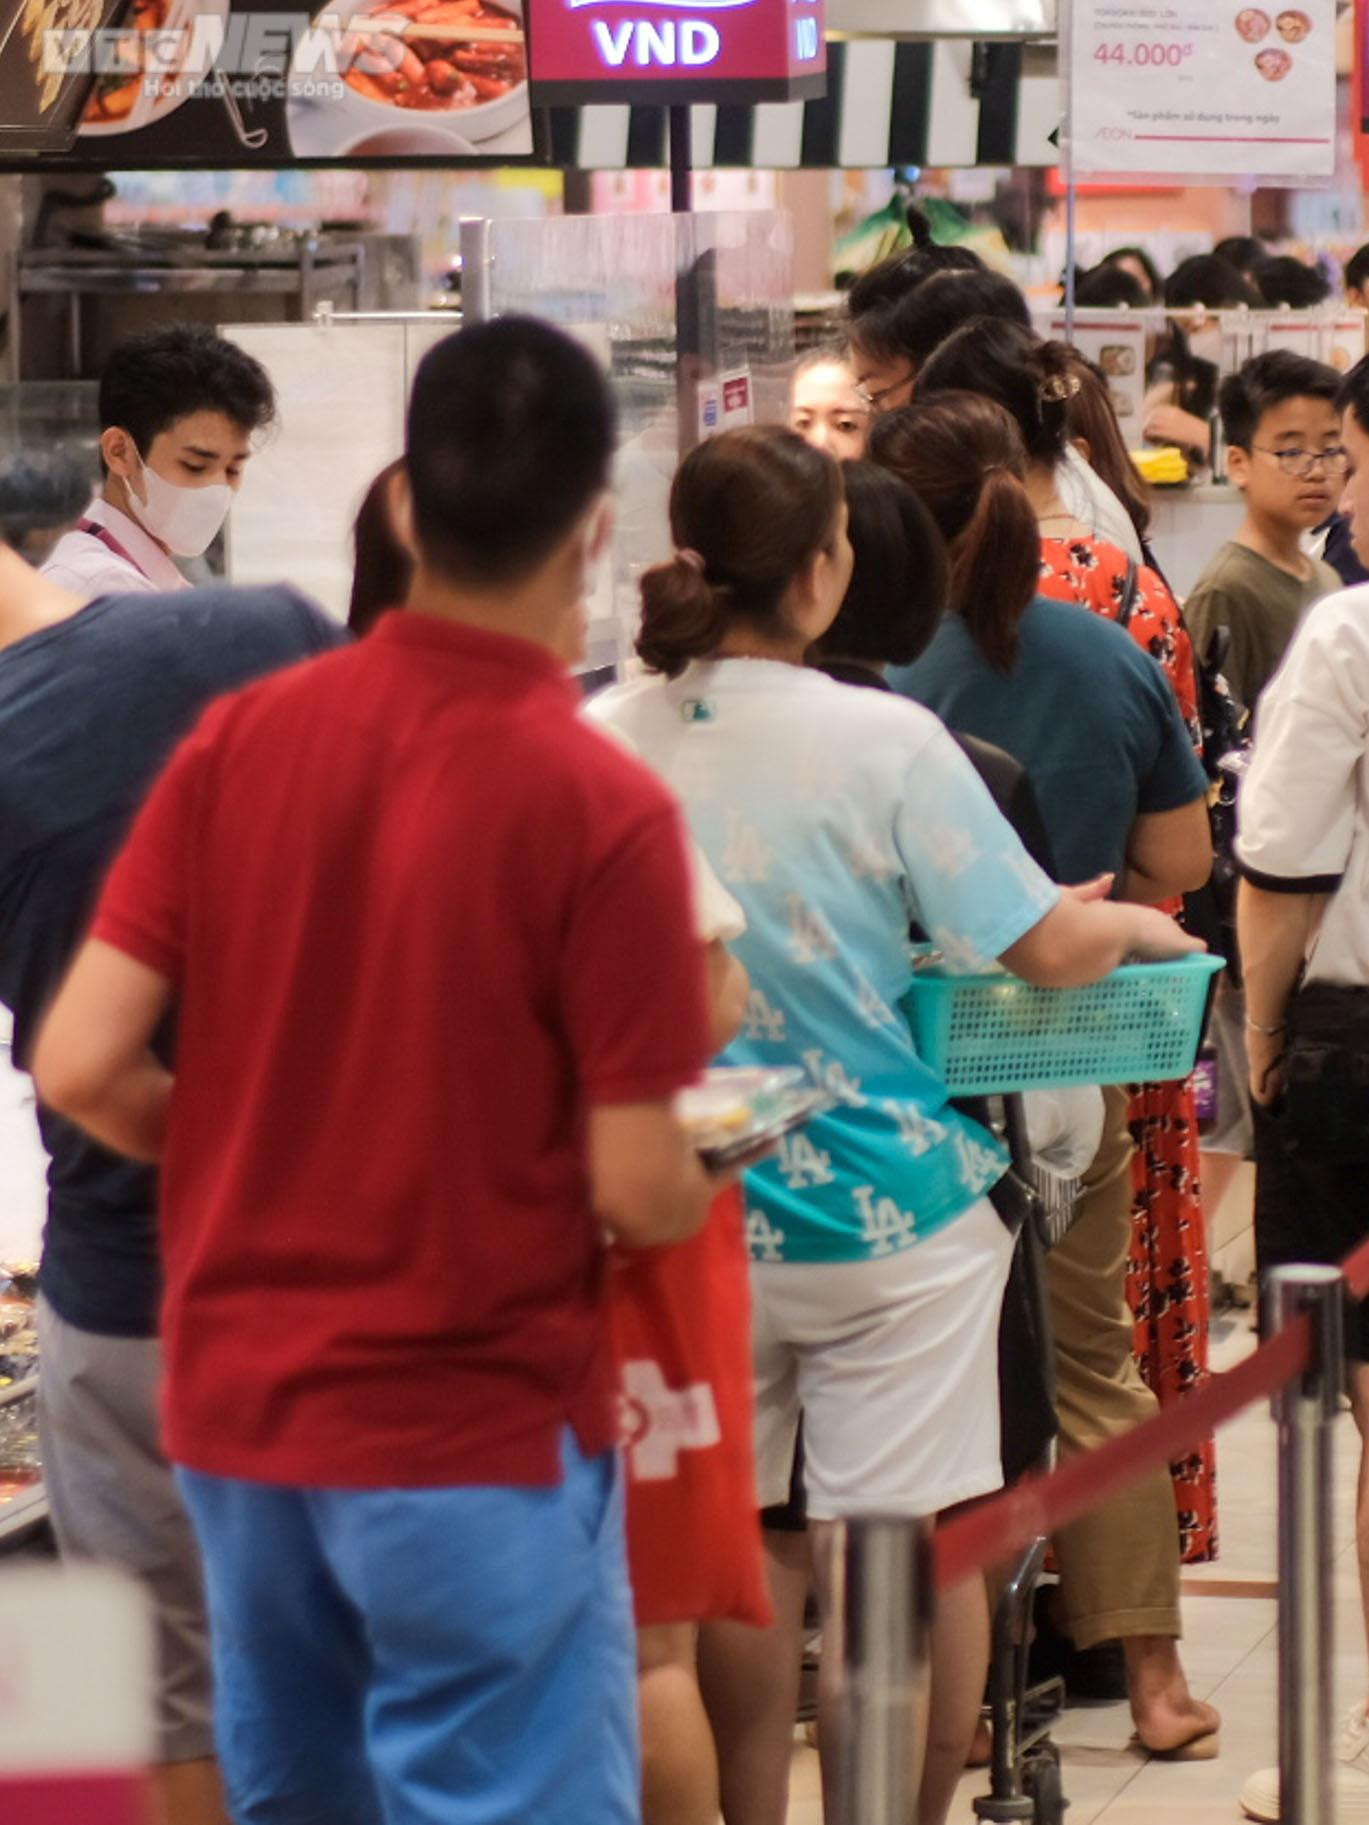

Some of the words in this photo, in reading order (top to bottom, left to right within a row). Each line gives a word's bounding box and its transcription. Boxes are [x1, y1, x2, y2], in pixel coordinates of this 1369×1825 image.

[592, 19, 721, 66] VND
[746, 1209, 785, 1262] A
[852, 1184, 918, 1256] LA
